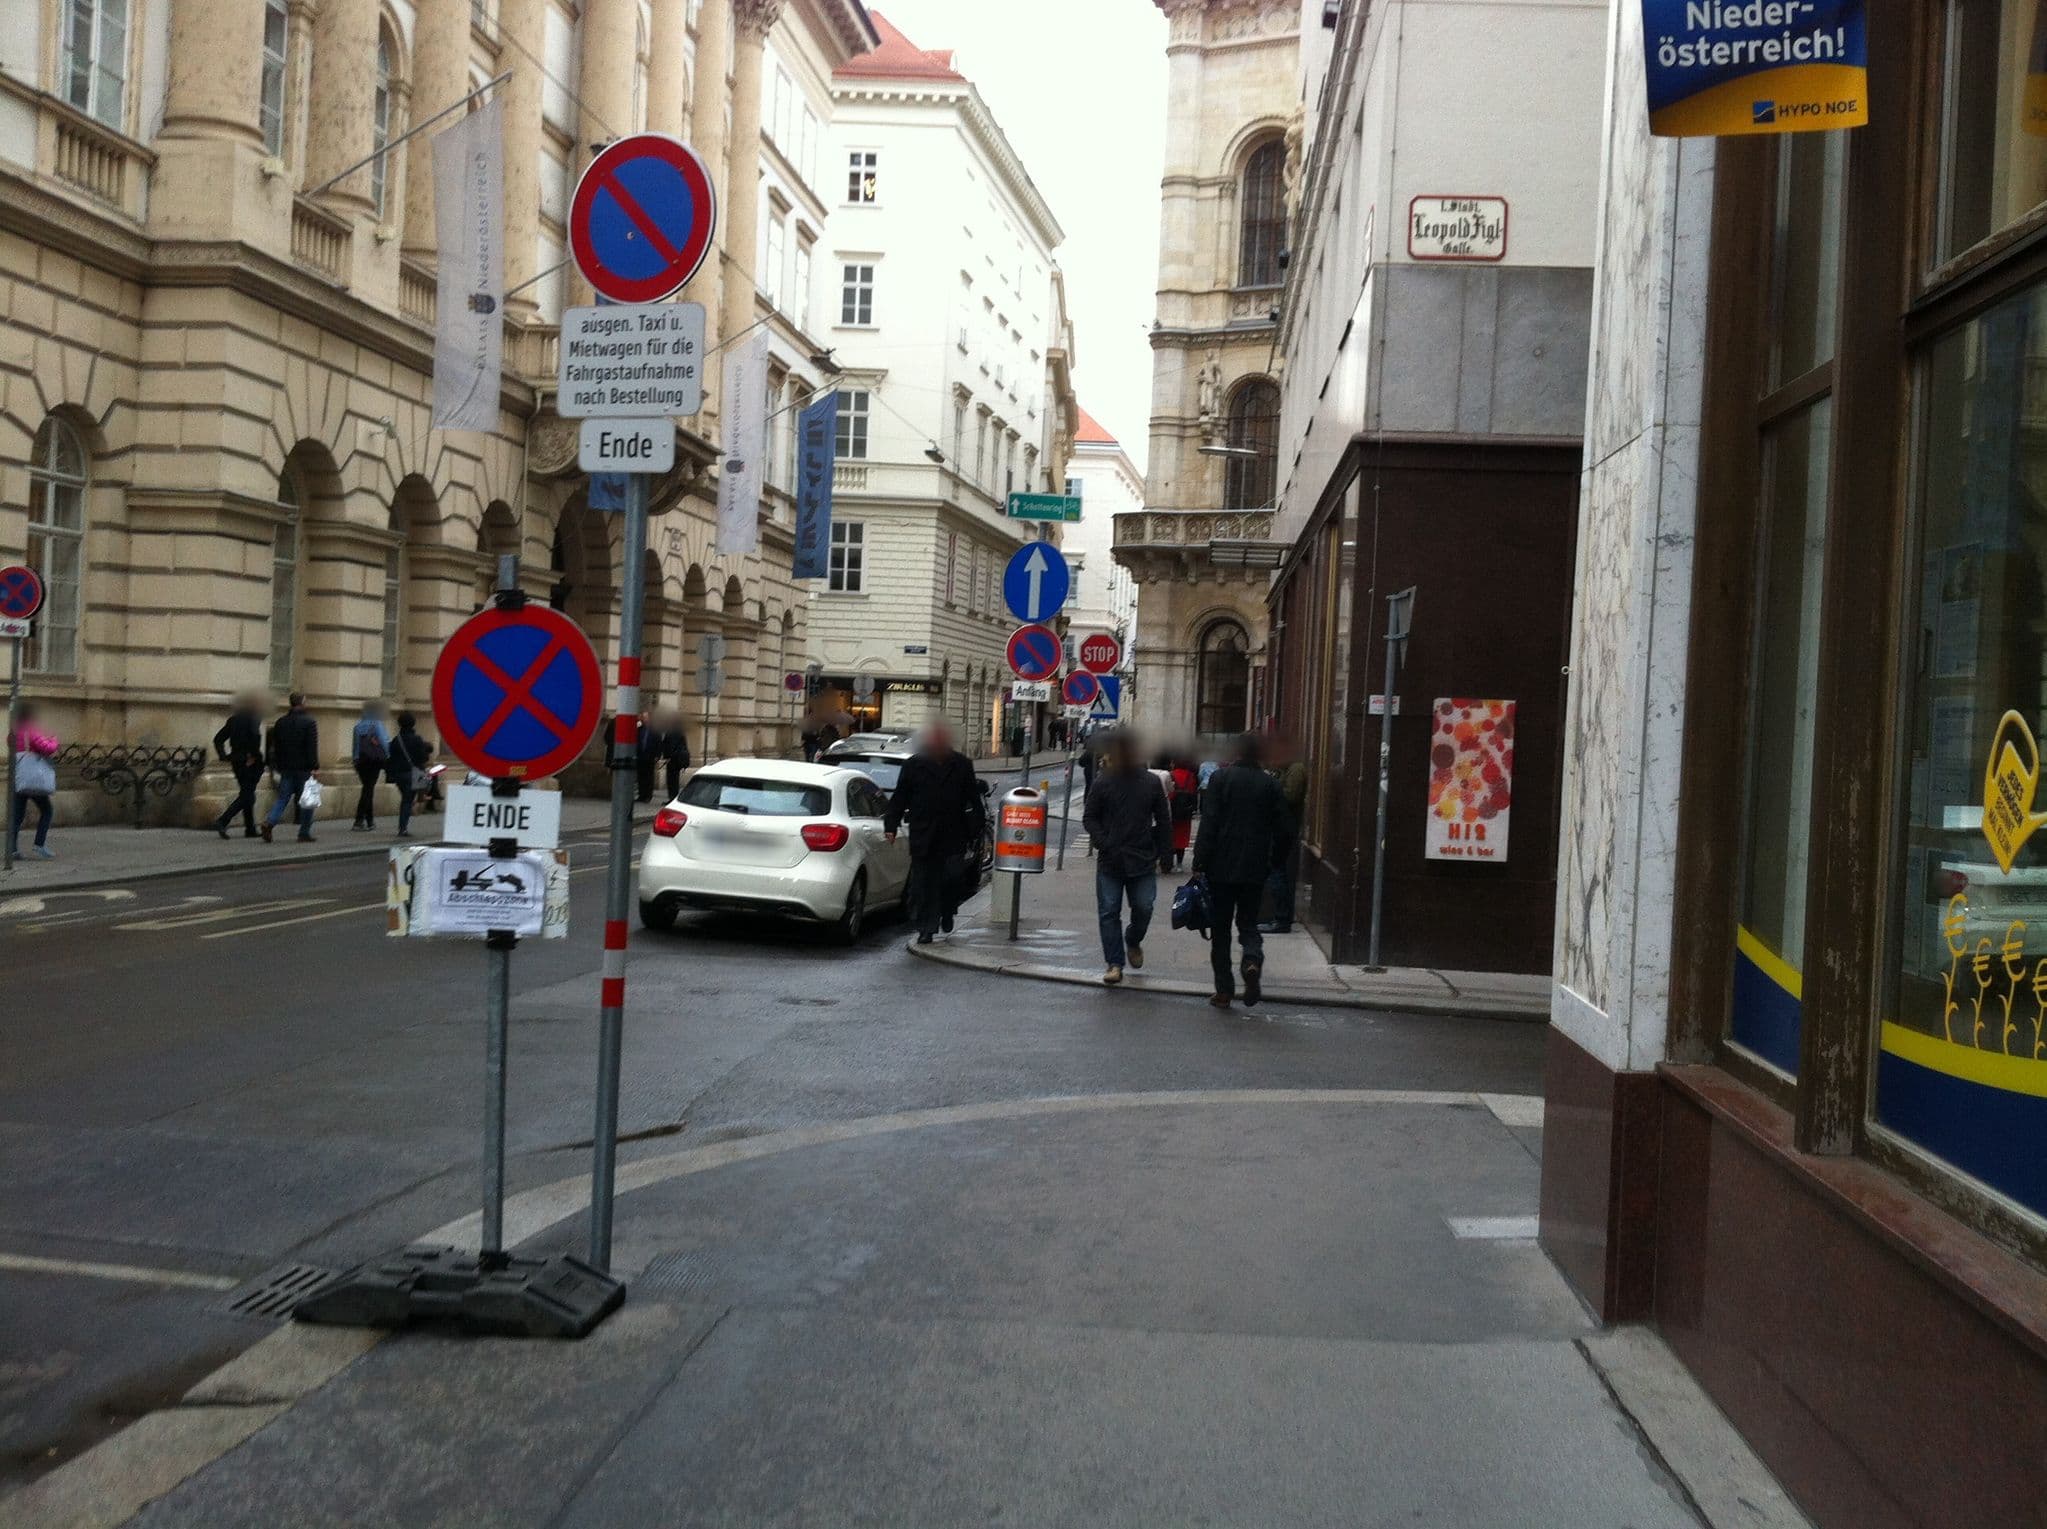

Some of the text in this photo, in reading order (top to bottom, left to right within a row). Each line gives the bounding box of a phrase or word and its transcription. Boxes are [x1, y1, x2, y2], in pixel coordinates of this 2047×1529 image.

[1686, 0, 1814, 31] Nieder-
[1659, 27, 1845, 67] österreich!
[1779, 100, 1858, 116] HYPO NOE
[474, 151, 489, 289] Niederösterreich
[1413, 213, 1471, 244] Leopold
[581, 313, 684, 336] ausgen. Taxi u.
[569, 336, 694, 360] Mietwagen für die
[565, 362, 695, 384] Fahrgastaufnahme
[574, 387, 684, 407] nach Bestellung
[599, 431, 653, 459] Ende
[1083, 645, 1115, 662] STOP
[1015, 685, 1047, 700] Anfang
[472, 802, 532, 831] ENDE
[1477, 846, 1495, 857] bar
